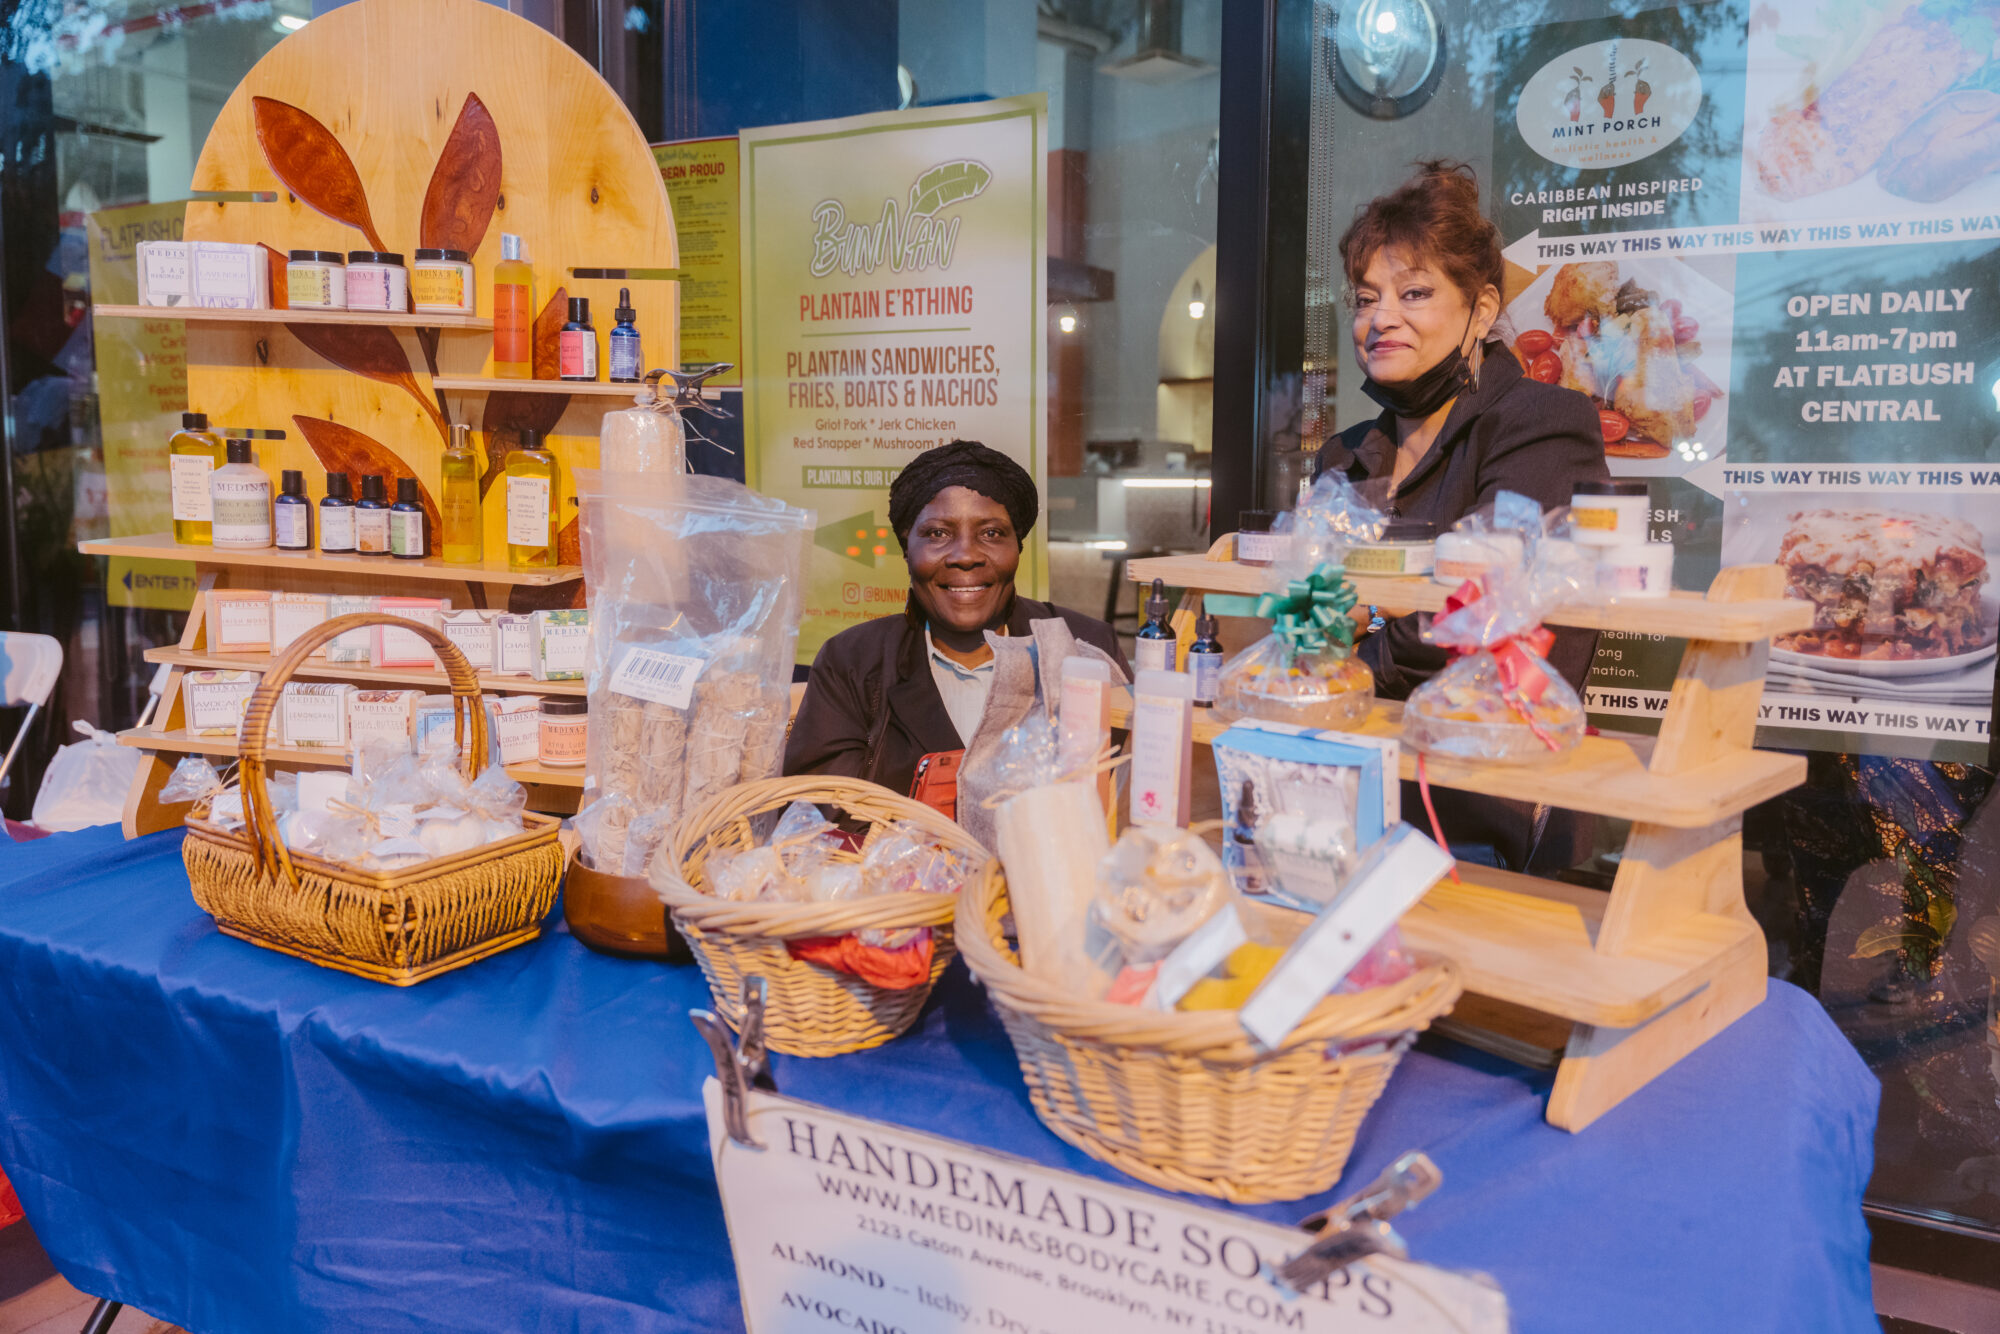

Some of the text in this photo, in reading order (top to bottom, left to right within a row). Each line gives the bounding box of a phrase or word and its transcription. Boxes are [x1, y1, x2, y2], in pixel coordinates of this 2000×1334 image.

[1552, 115, 1662, 139] MINT PORCH
[1605, 136, 1645, 149] health
[1650, 135, 1657, 144] &
[1579, 151, 1632, 163] wellness
[689, 162, 726, 178] PROUD
[1510, 177, 1703, 206] CARIBBEAN INSPIRED
[1542, 199, 1666, 224] RIGHT INSIDE
[1537, 215, 2000, 258] THIS WAY THIS WAY THIS WAY THIS WAY THIS WAY
[800, 285, 973, 322] PLANTAIN E'RTHING
[1787, 288, 1973, 317] OPEN DAILY
[1795, 327, 1958, 354] 11am-7pm
[786, 344, 1000, 378] PLANTAIN SANDWICHES,
[1773, 361, 1975, 388] AT FLATBUSH
[788, 378, 998, 411] FRIES, BOATS & NACHOS
[1801, 399, 1942, 423] CENTRAL
[843, 418, 868, 431] Pork
[878, 418, 902, 431] Jerk
[905, 417, 956, 431] Chicken
[793, 437, 815, 449] Red
[817, 438, 863, 452] Snapper
[873, 437, 935, 450] Mushroom
[807, 469, 851, 485] PLANTAIN
[852, 470, 859, 485] IS
[863, 470, 883, 486] OUR
[1723, 470, 1766, 484] THIS
[1770, 470, 1813, 484] WAY
[1818, 470, 1862, 485] THIS
[1867, 471, 1912, 485] WAY
[1917, 471, 1963, 486] THIS
[134, 573, 179, 591] ENTER
[843, 610, 862, 619] your
[354, 705, 404, 713] MEDINA'S
[1600, 694, 1639, 709] THIS
[548, 725, 587, 734] MEDINA'S
[1777, 706, 1821, 722] THIS
[1826, 709, 1870, 725] WAY
[1874, 712, 1919, 729] THIS
[1925, 716, 1970, 732] WAY
[783, 1116, 1394, 1320] HANDEMADE SOPS
[815, 1171, 1306, 1331] WWW.MEDINASBODYCARE.COM
[856, 1213, 1194, 1326] 2123 Caton Avenue, Brooklyn, NY
[770, 1242, 886, 1290] ALMOND
[916, 1284, 981, 1325] Itchy,
